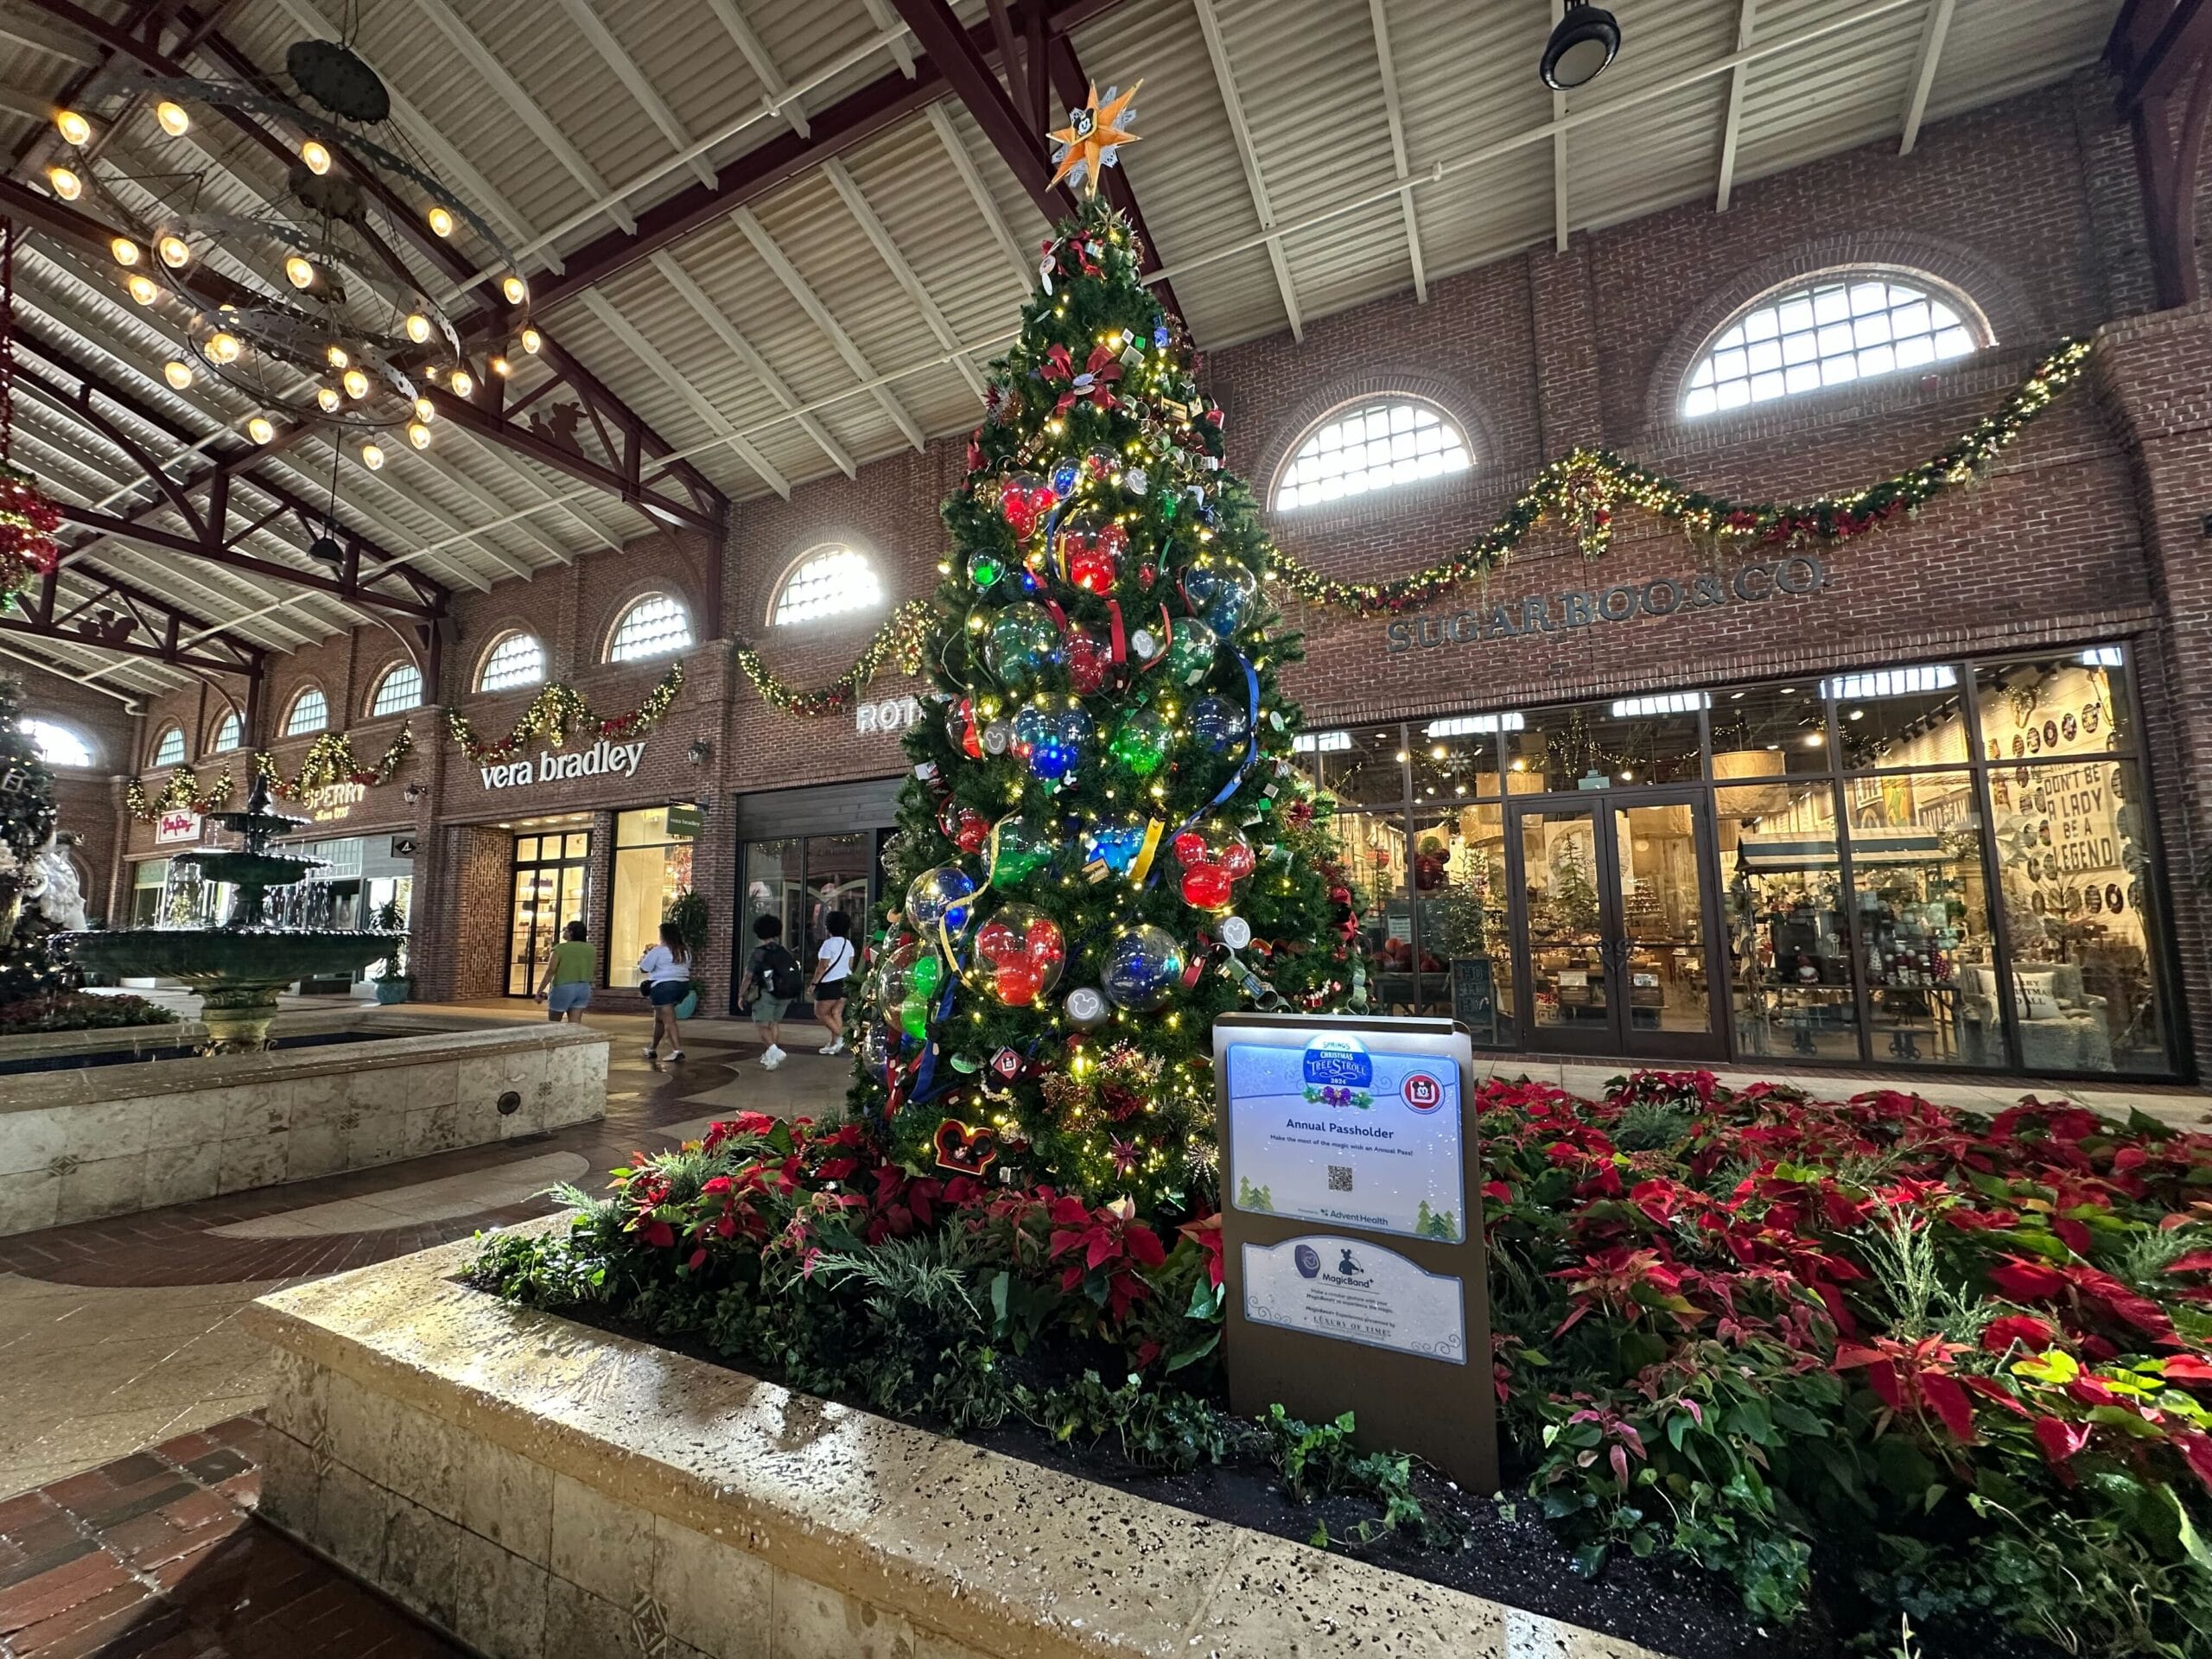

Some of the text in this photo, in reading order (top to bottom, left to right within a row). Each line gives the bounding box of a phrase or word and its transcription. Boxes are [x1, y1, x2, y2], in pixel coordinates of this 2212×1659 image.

[856, 697, 925, 732] ROT
[480, 741, 646, 791] vera bradley
[2044, 770, 2079, 796] DON'T
[2084, 764, 2101, 785] BE
[302, 781, 365, 810] SPERRY
[2047, 787, 2101, 822] A LADY
[2063, 817, 2093, 840] BE A
[2053, 837, 2113, 872] LEGEND
[1320, 1052, 1354, 1061] CHRISTMAS
[1286, 1118, 1395, 1139] Annual Passholder
[1374, 1146, 1395, 1154] Annual
[1331, 1210, 1389, 1225] AdventHealth
